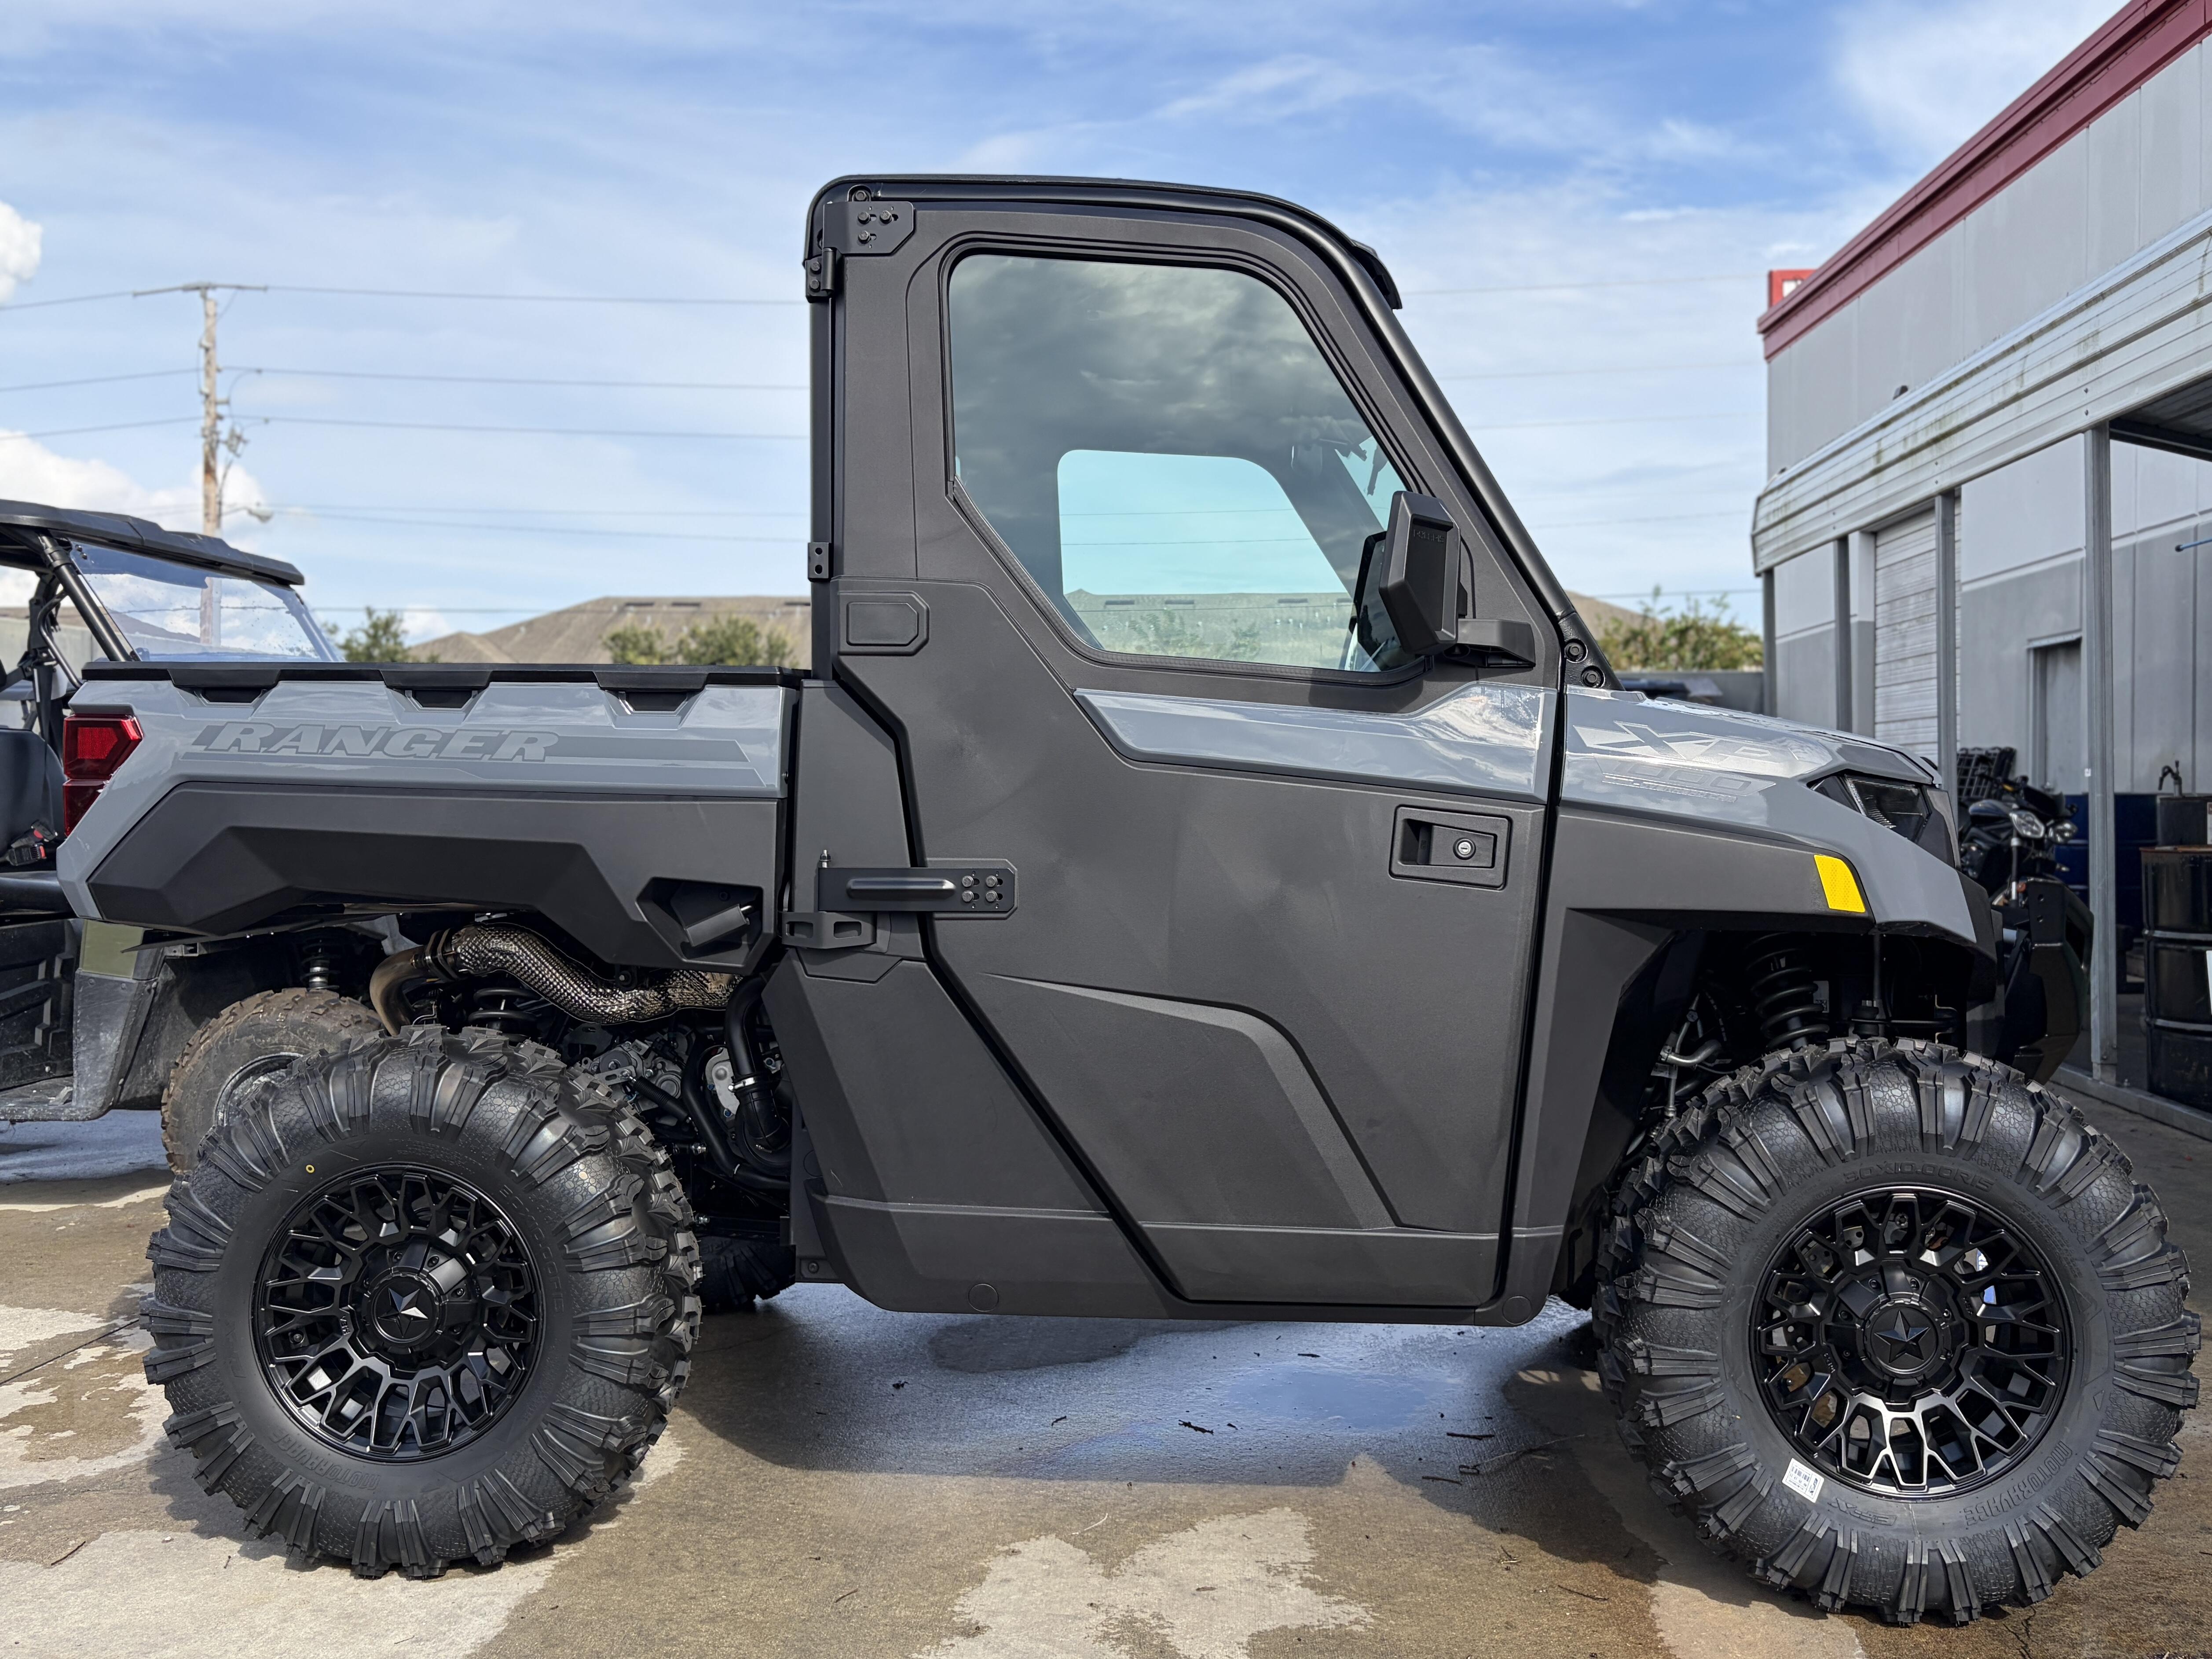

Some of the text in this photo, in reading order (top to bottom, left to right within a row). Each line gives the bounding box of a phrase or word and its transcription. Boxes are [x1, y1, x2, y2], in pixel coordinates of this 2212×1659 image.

[204, 721, 559, 762] RANGER
[1572, 720, 1798, 764] XP
[1611, 760, 1752, 792] 1000
[269, 1432, 381, 1490] MOTORAVAGE
[1964, 1440, 2073, 1525] MOTORAVAGE
